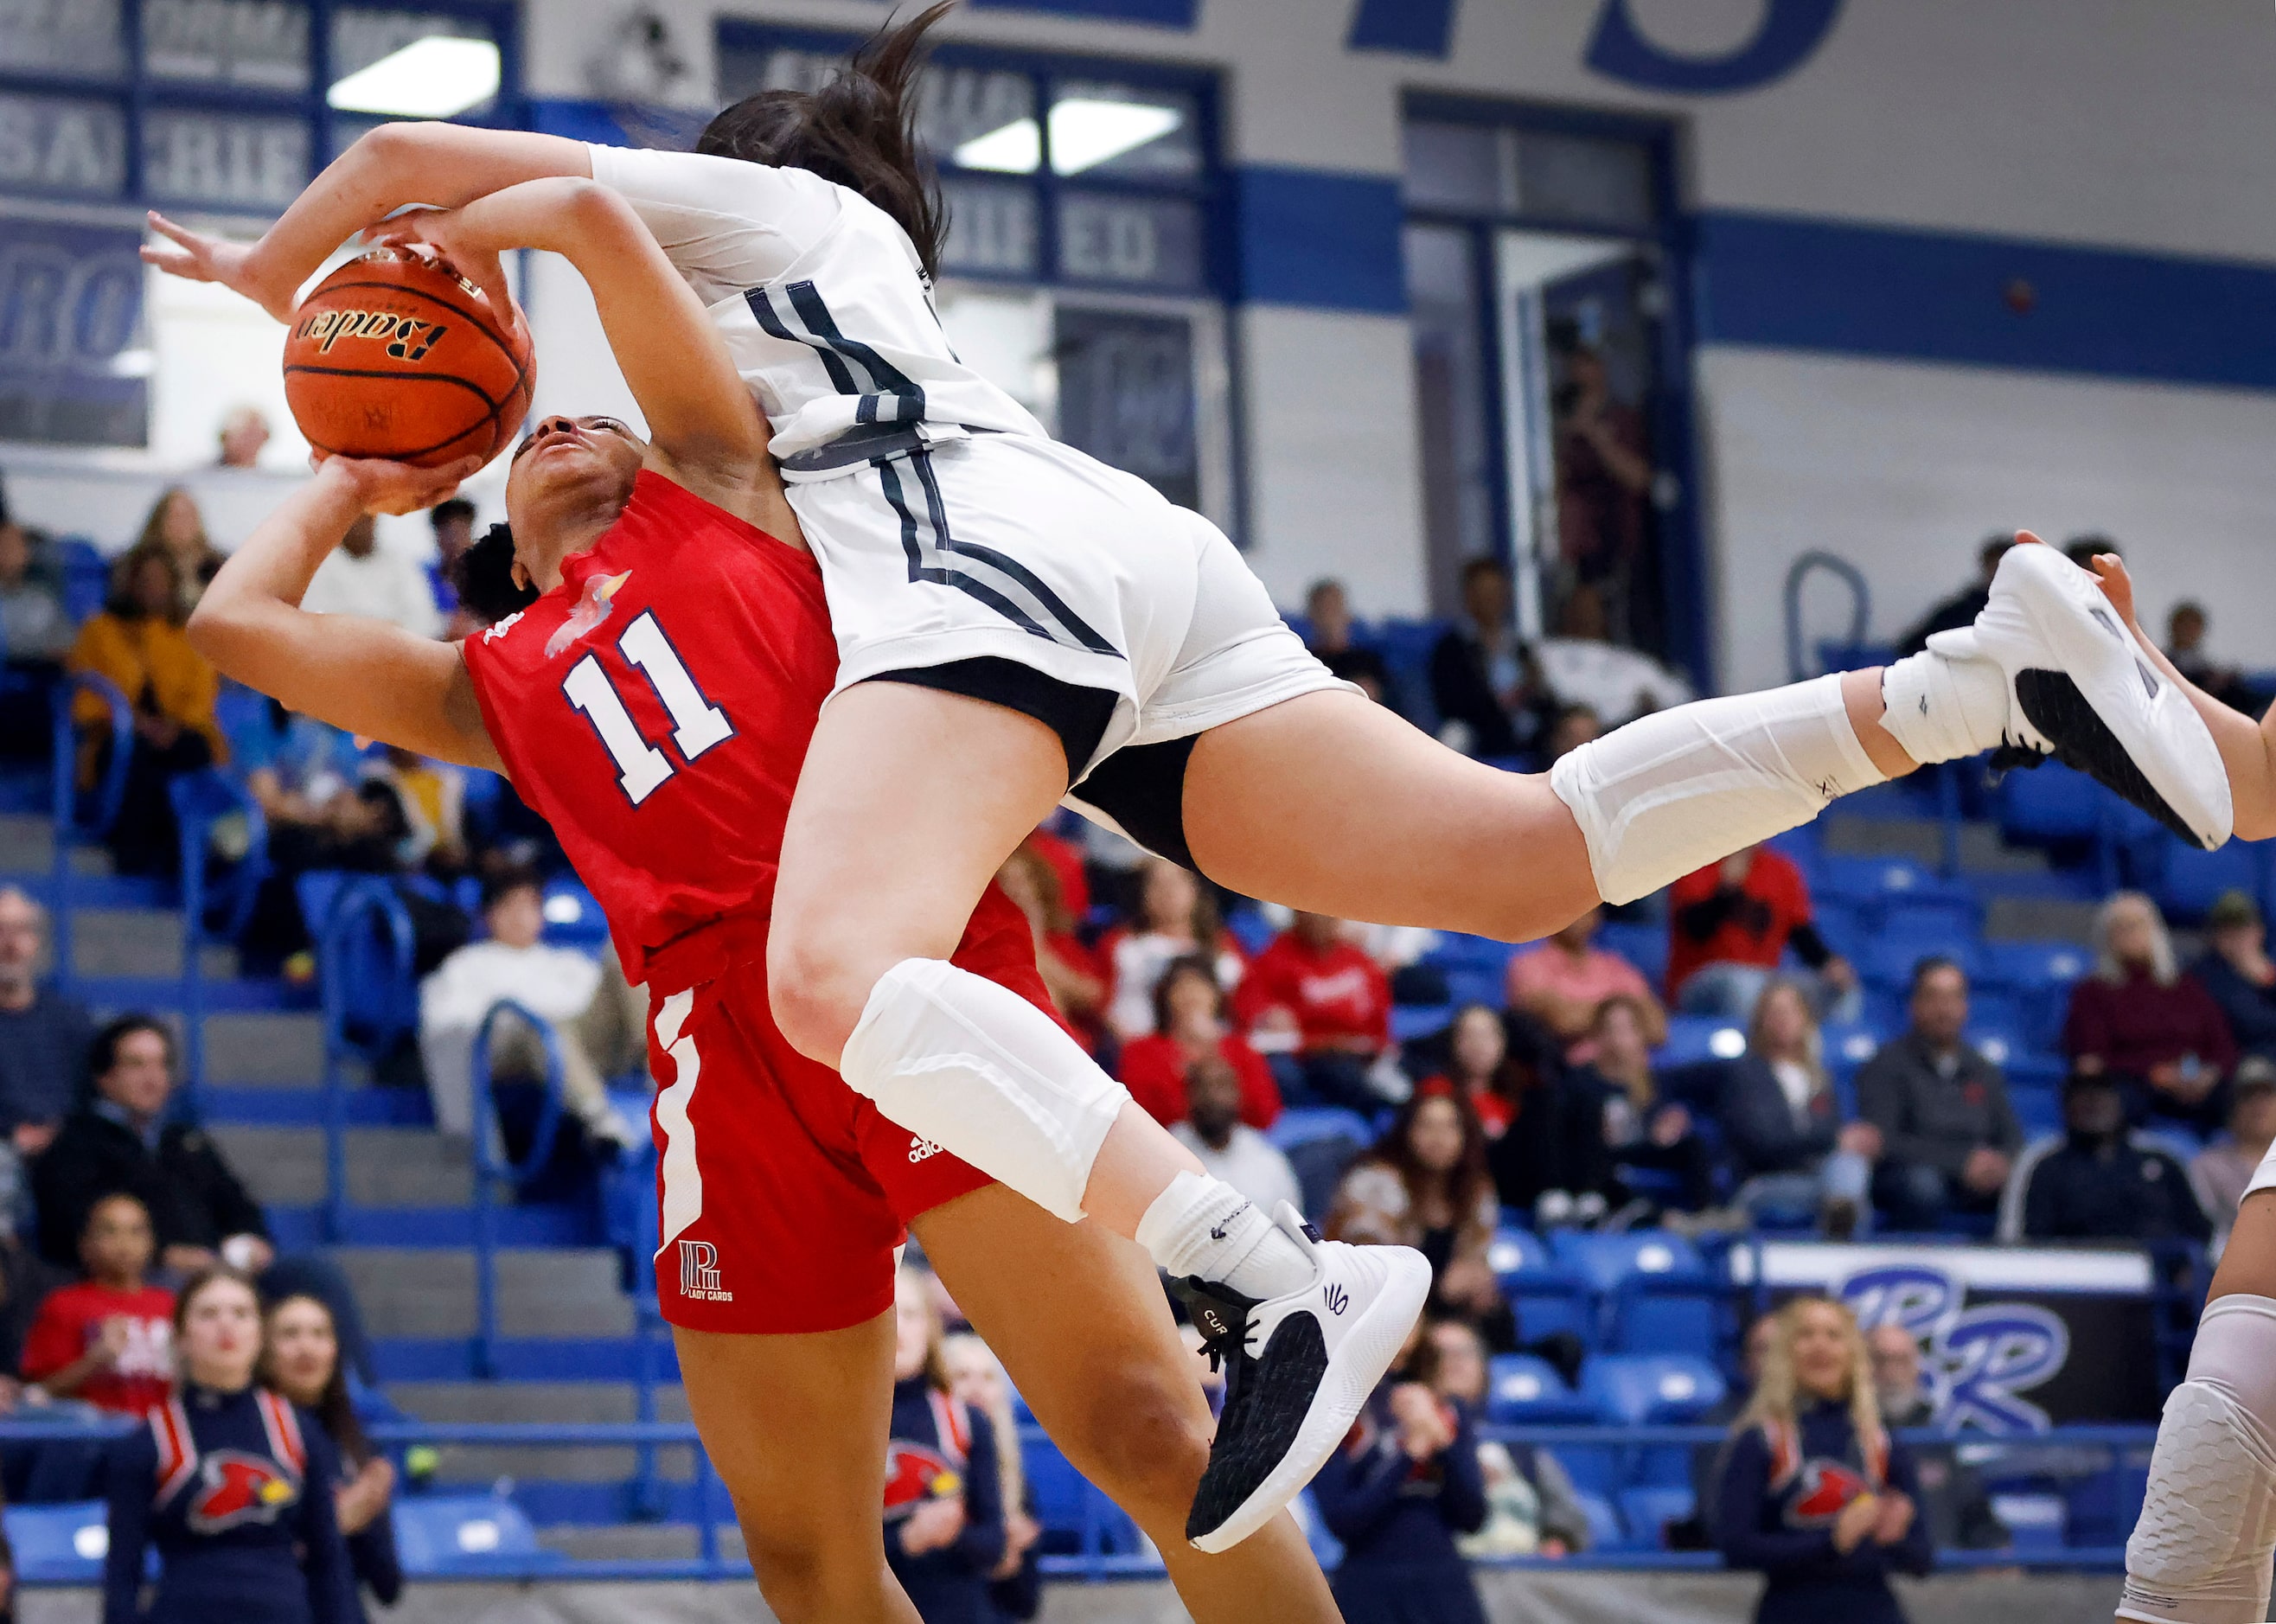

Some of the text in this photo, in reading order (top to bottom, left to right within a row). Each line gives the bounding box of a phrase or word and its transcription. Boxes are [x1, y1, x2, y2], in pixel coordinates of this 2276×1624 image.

[297, 310, 449, 363] Baden
[560, 605, 740, 810] 11
[688, 1288, 733, 1301] LADY CARDS
